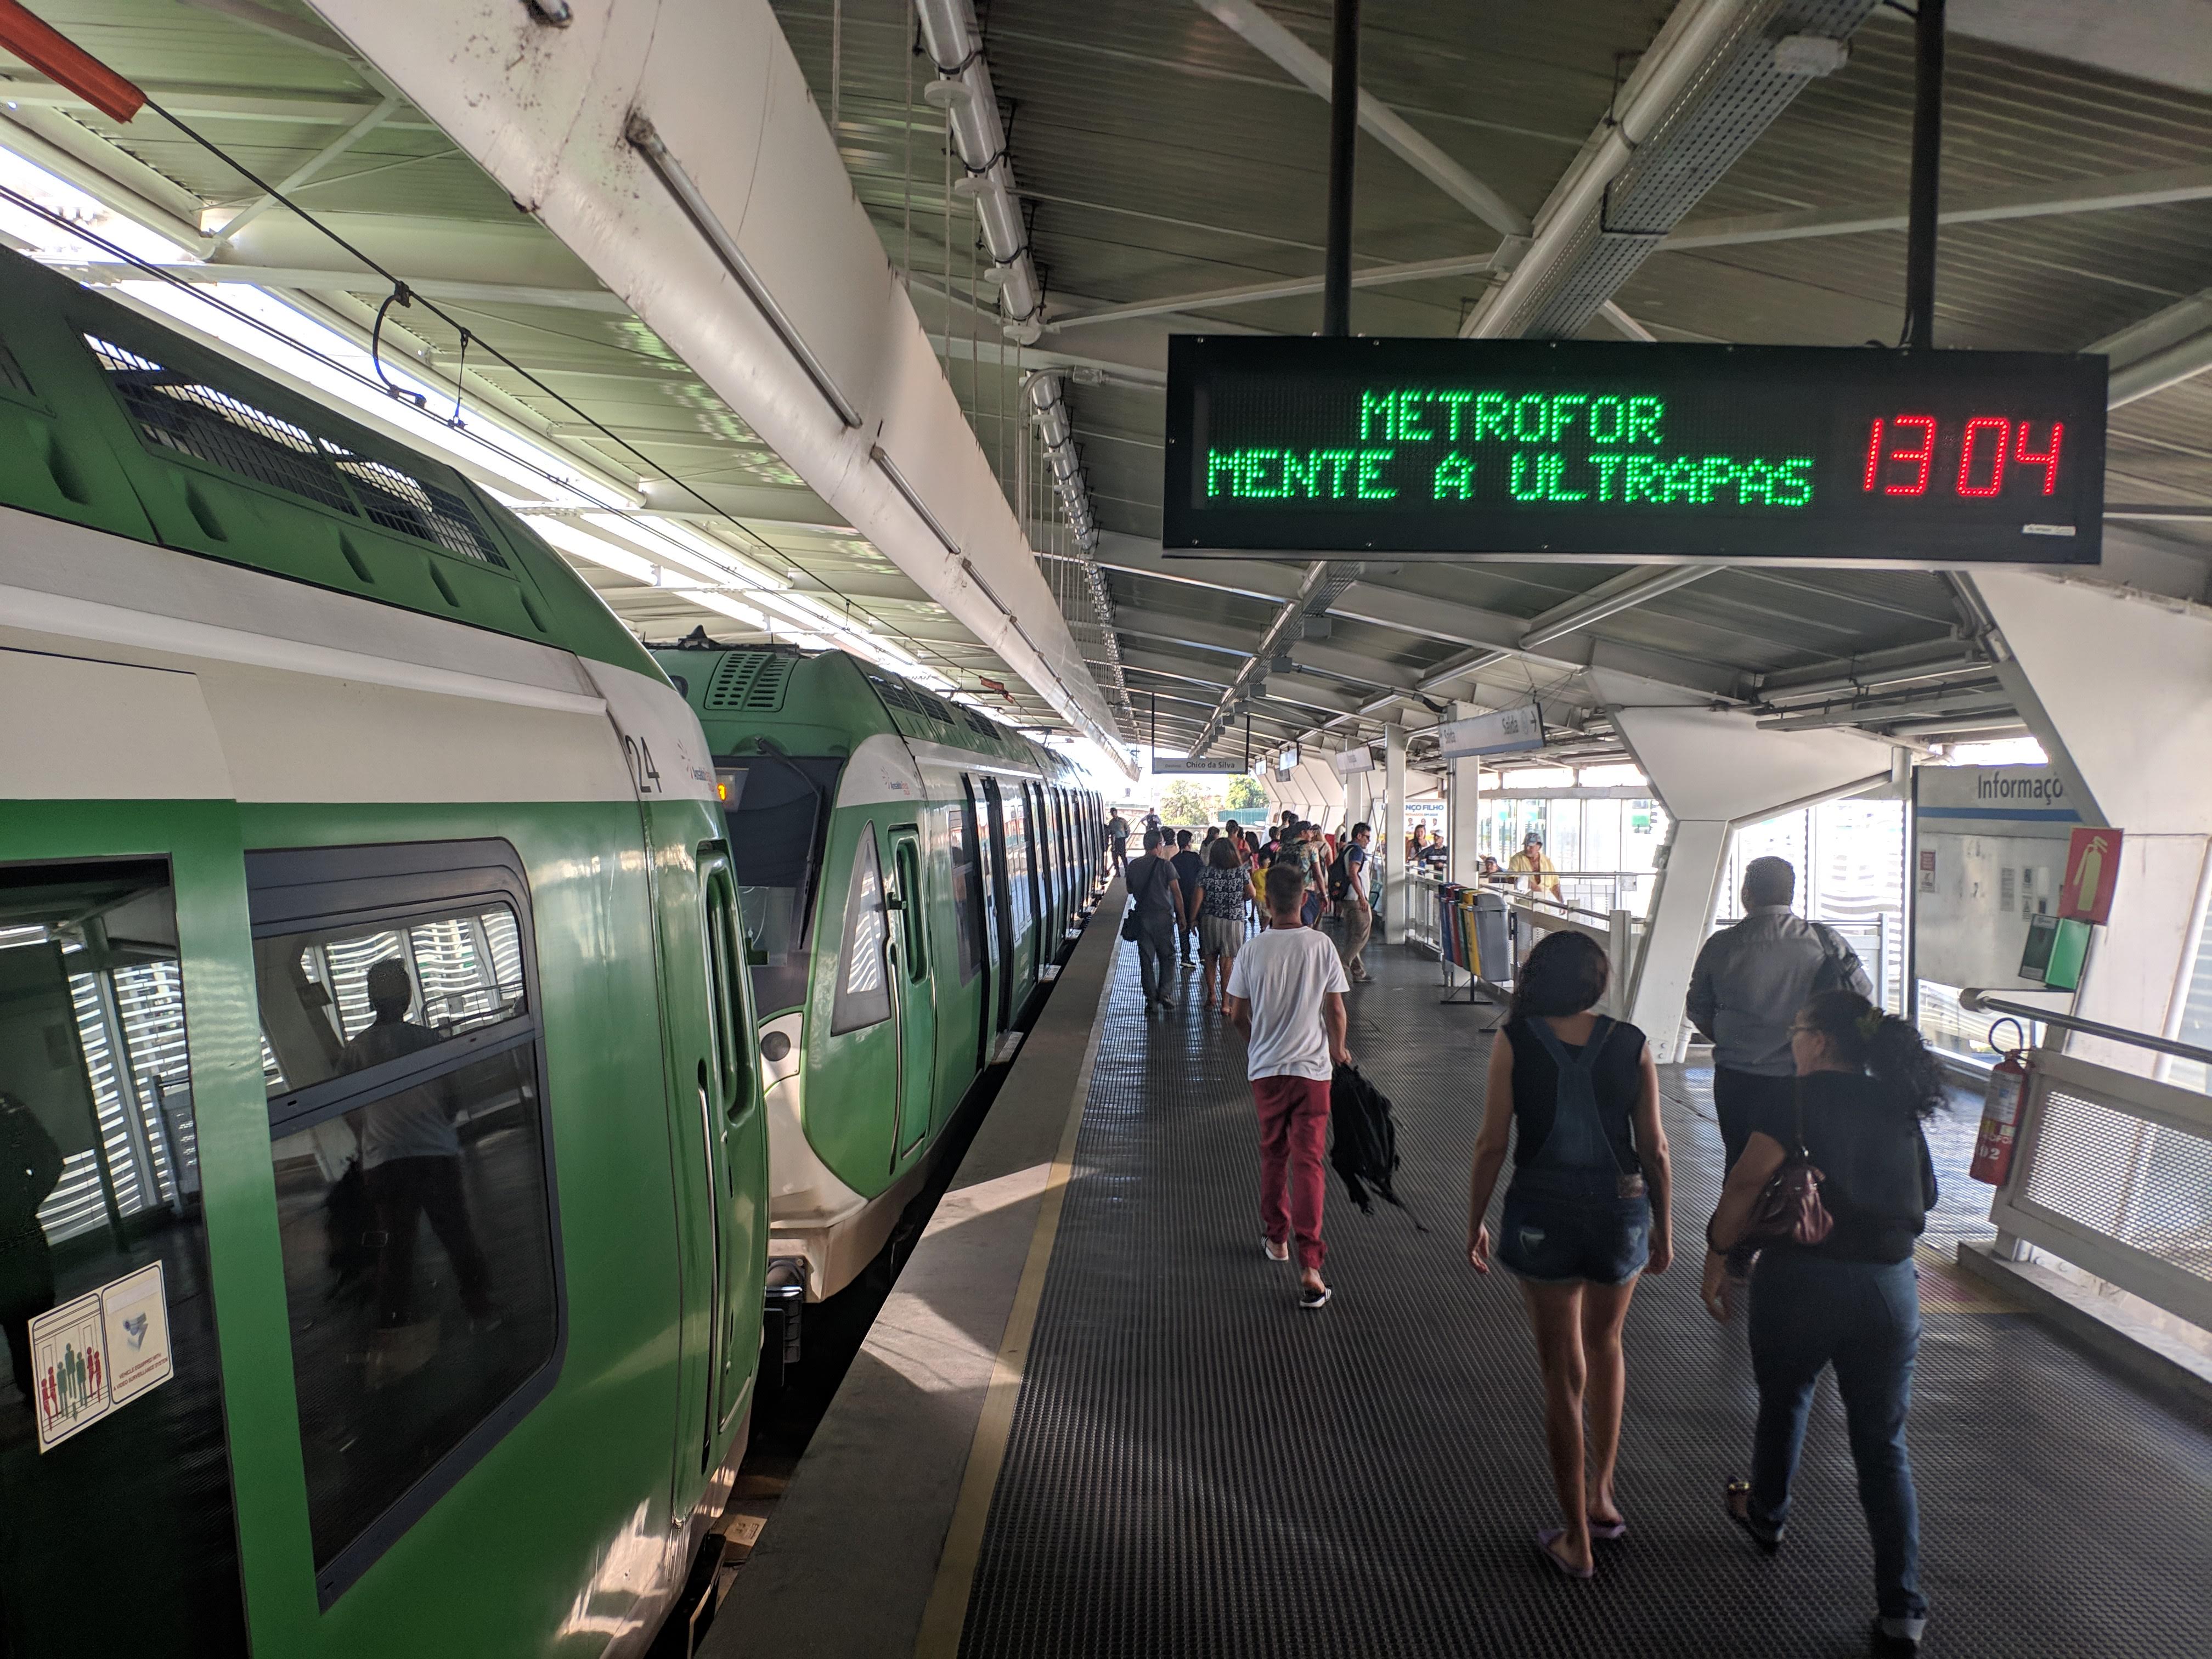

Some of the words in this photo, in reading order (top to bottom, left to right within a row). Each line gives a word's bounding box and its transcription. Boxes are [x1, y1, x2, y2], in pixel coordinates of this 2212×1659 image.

[1361, 389, 1666, 444] METROFOR
[1207, 448, 1398, 500] MENTE
[1434, 450, 1477, 500] A
[1510, 451, 1814, 507] ULTRAPAS
[625, 735, 662, 793] 24
